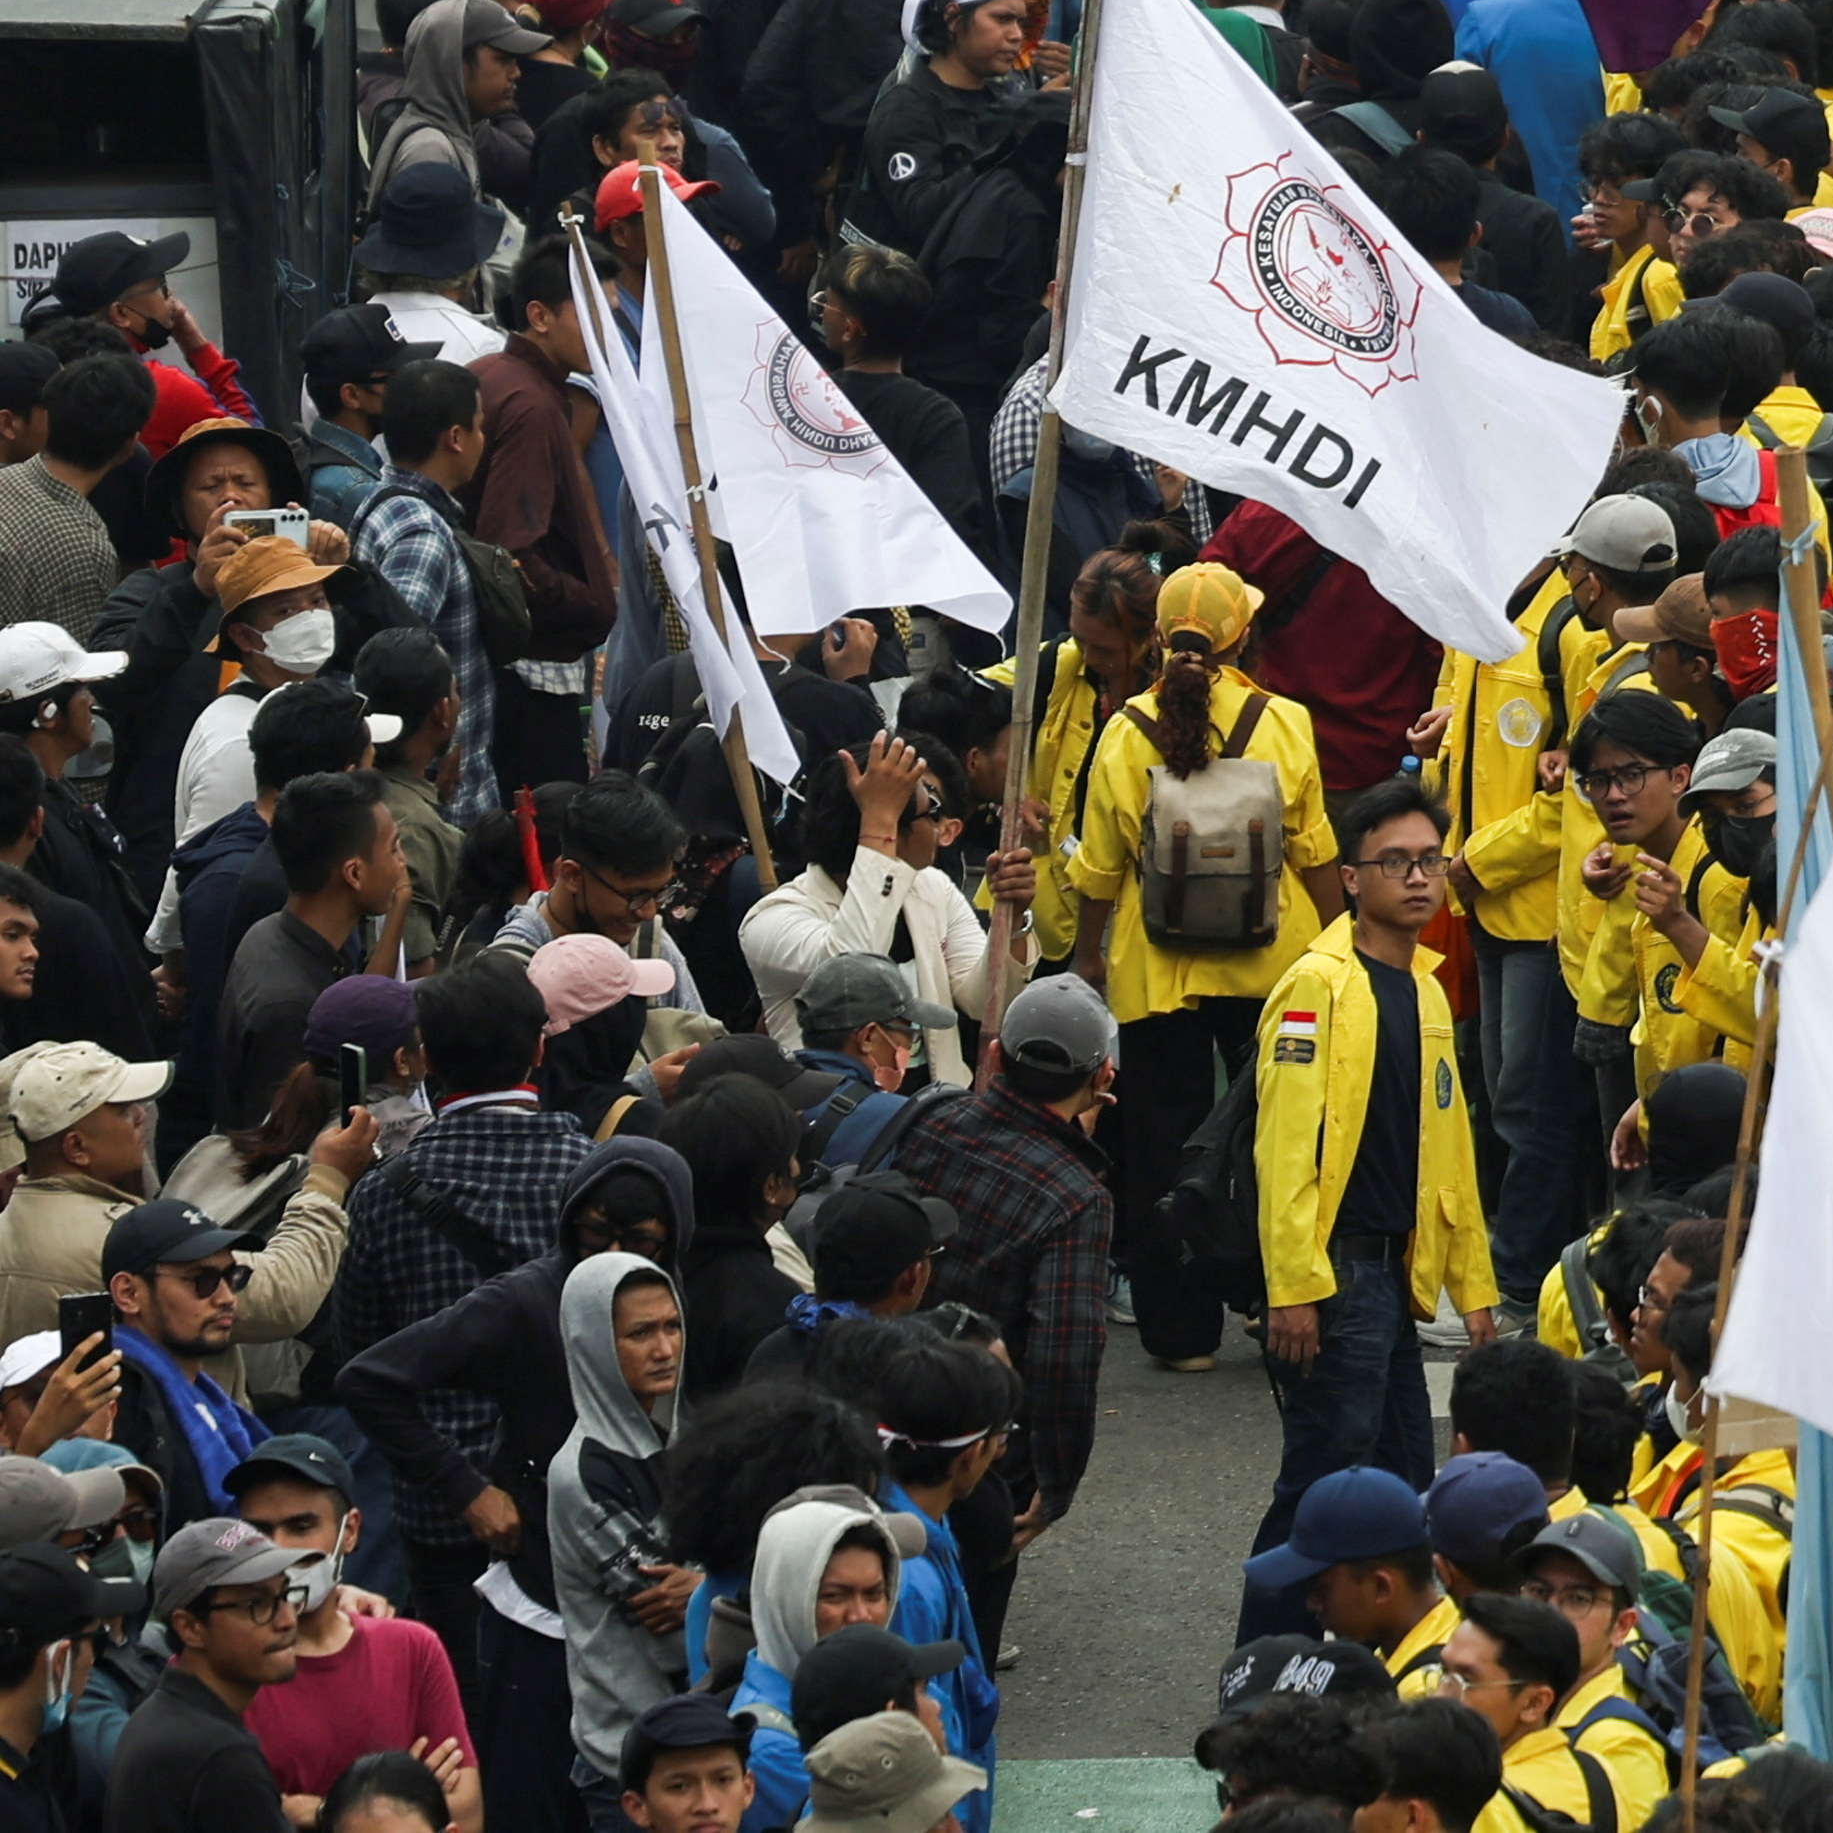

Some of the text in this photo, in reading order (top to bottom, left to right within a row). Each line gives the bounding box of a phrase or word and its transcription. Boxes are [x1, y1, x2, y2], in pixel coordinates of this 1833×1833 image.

[1258, 186, 1297, 267] KESATUAN
[1270, 281, 1349, 348] INDONESIA
[1114, 334, 1383, 510] KMHDI
